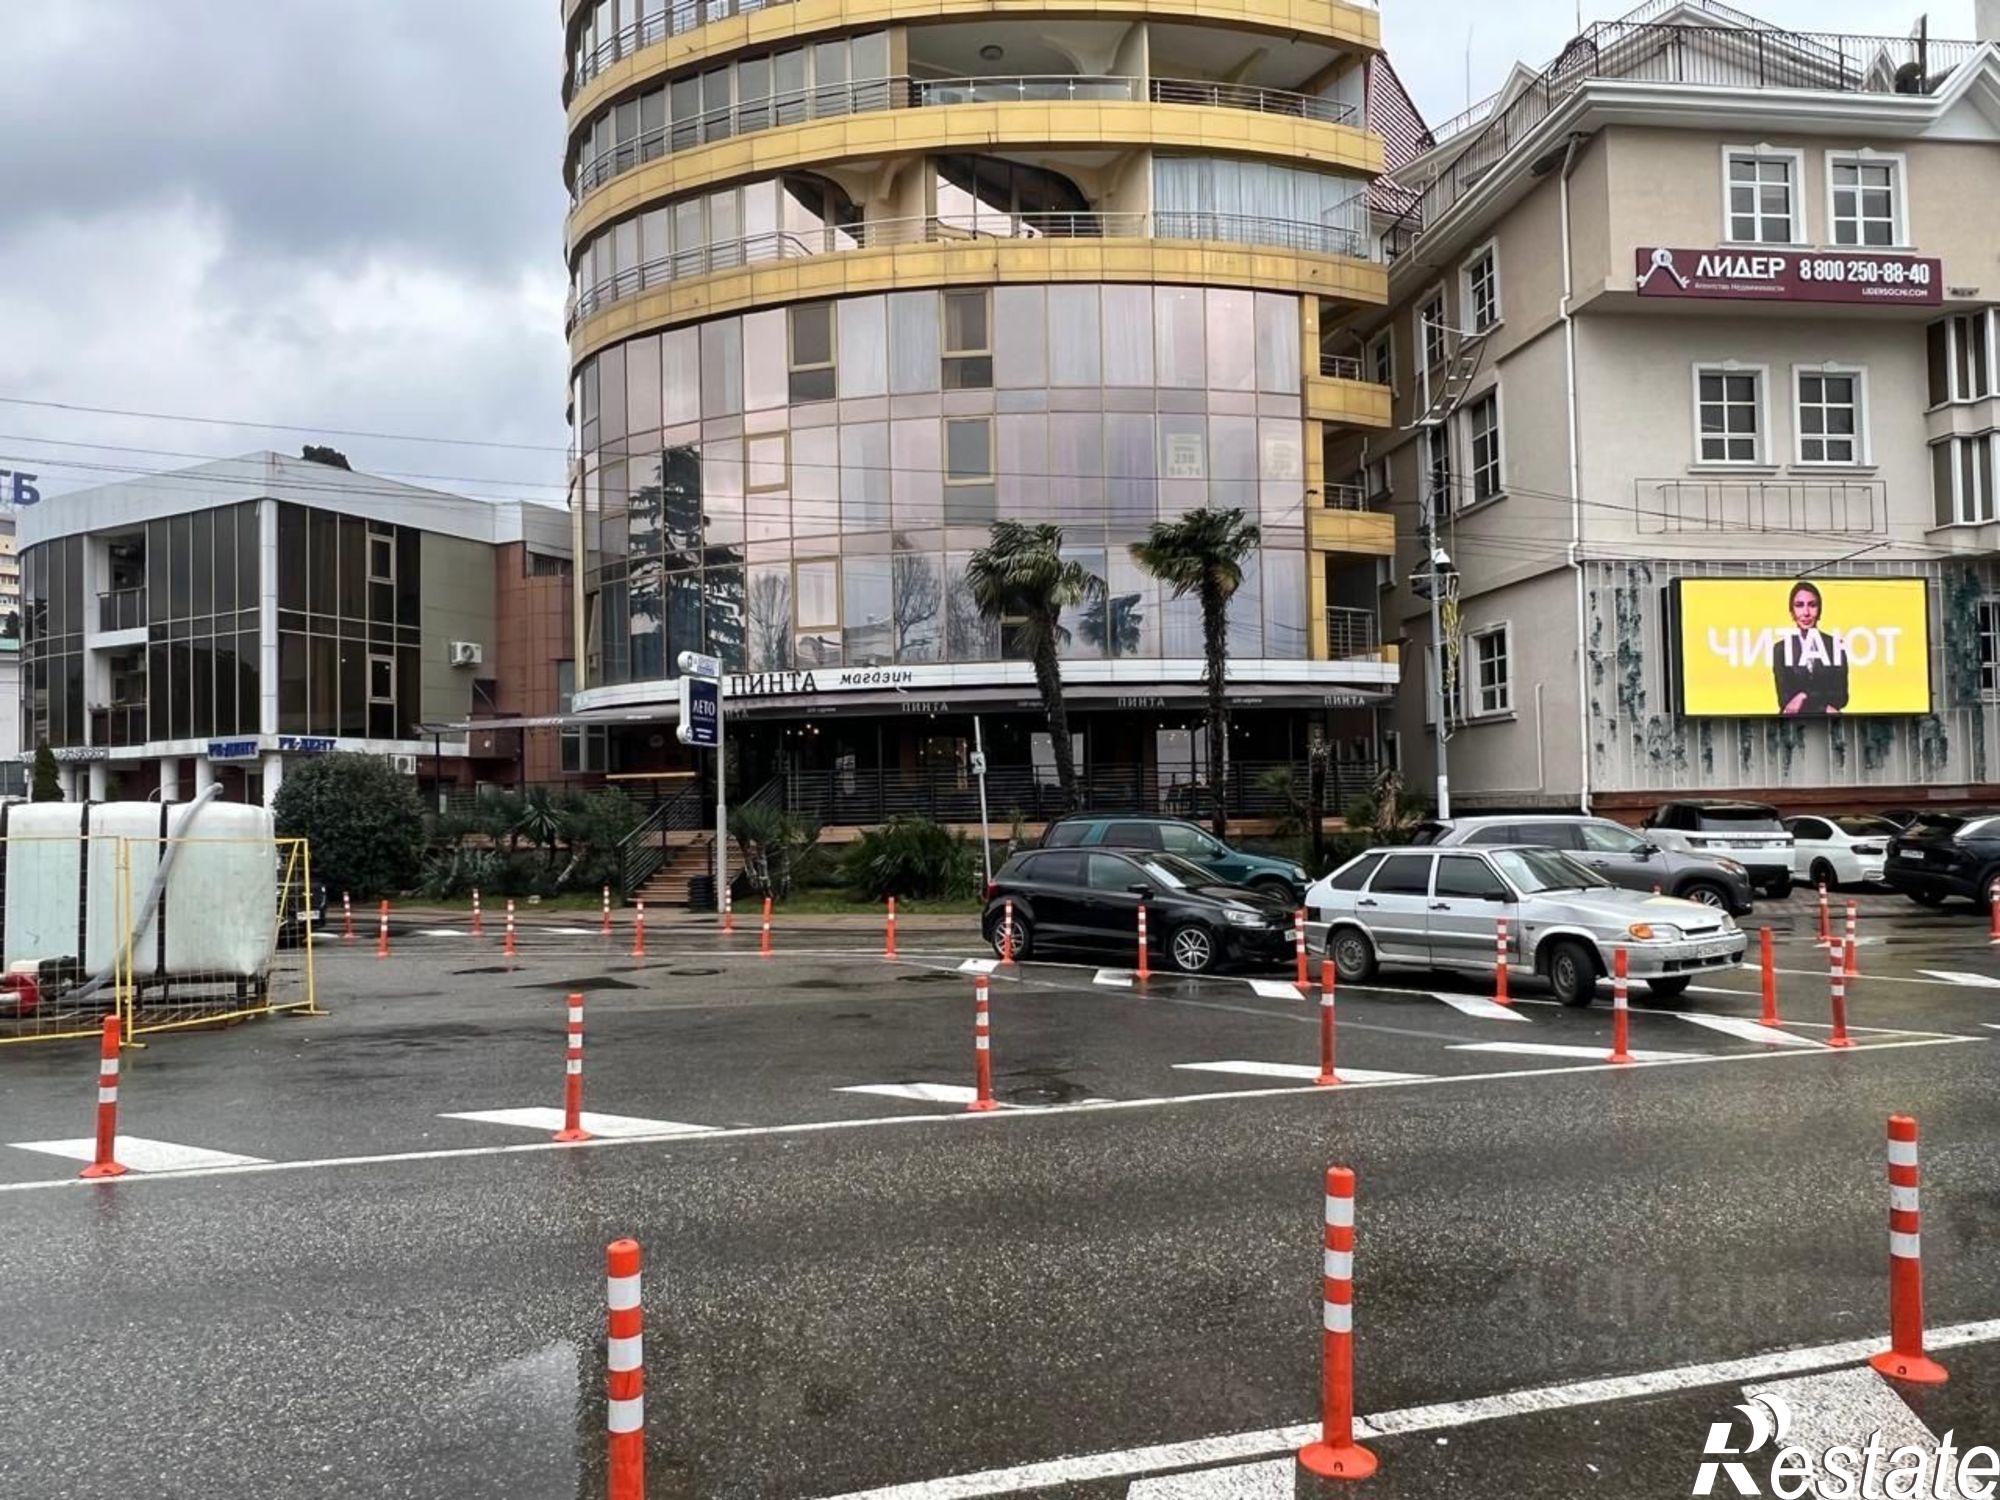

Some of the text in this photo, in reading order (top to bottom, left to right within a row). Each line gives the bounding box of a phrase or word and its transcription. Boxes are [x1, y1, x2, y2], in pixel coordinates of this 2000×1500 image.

[1696, 254, 1786, 279] ЛИДЕР
[1800, 259, 1930, 284] 8 800 250-88-40
[1707, 625, 1904, 668] ЧИТАЮТ
[731, 671, 913, 694] ПИНТА магазин
[693, 700, 715, 716] ЛЕТО
[902, 702, 949, 712] ПИНТА
